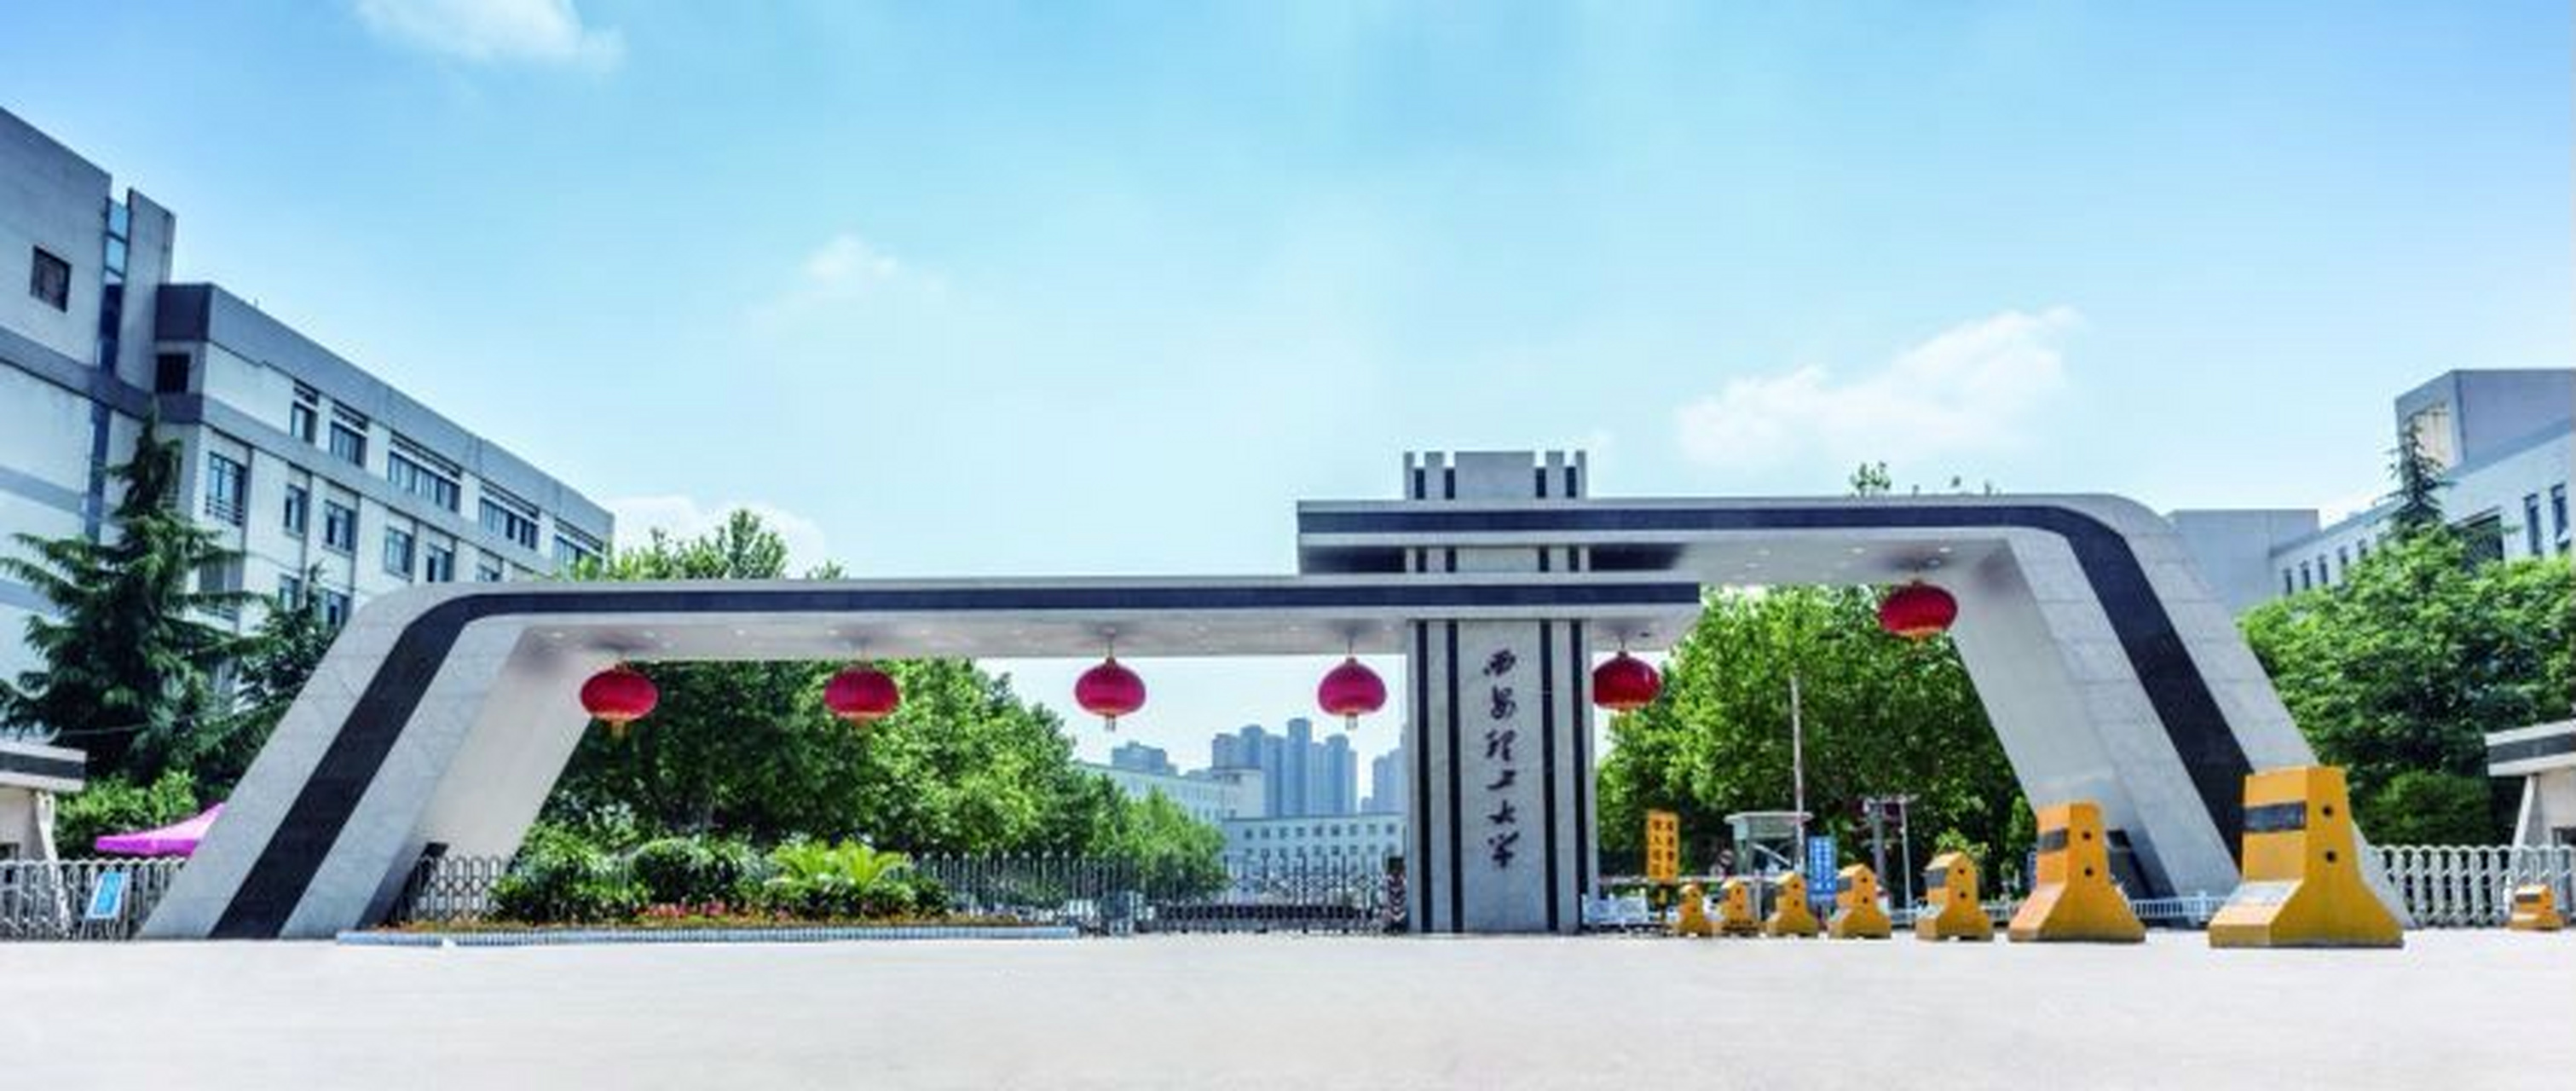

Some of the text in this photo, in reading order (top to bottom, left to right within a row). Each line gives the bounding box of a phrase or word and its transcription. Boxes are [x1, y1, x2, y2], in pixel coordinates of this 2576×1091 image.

[1483, 649, 1520, 869] 西安理工大学
